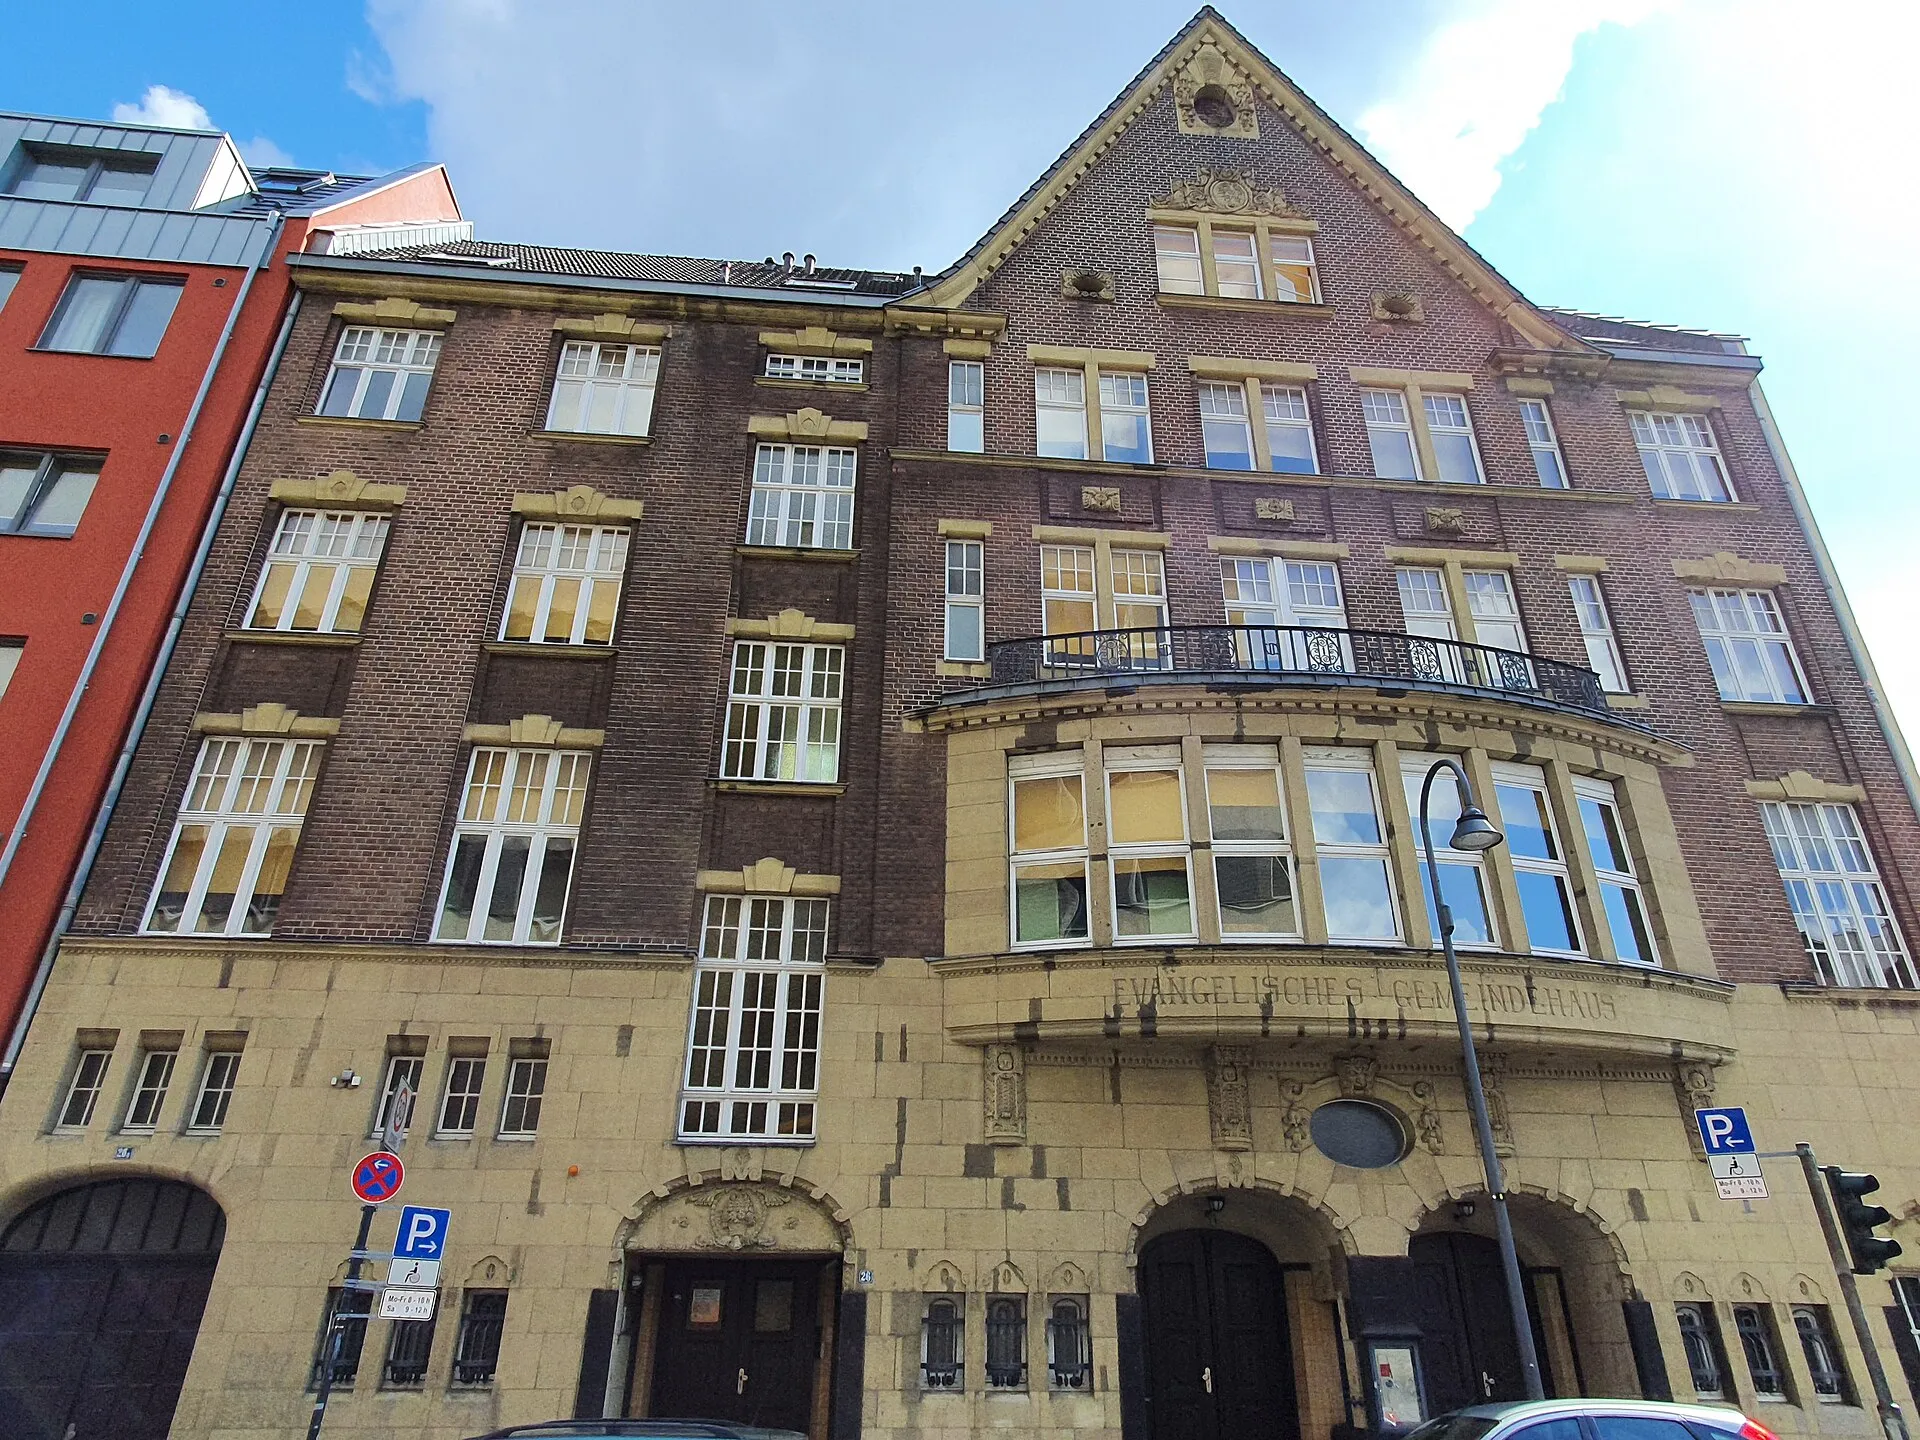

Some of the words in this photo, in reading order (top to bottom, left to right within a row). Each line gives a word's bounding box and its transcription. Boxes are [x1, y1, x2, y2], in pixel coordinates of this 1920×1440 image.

[1112, 974, 1364, 1007] EVANGELISCHES
[1704, 1114, 1734, 1149] P
[405, 1213, 437, 1252] P
[388, 1295, 407, 1303] Mo-Fr
